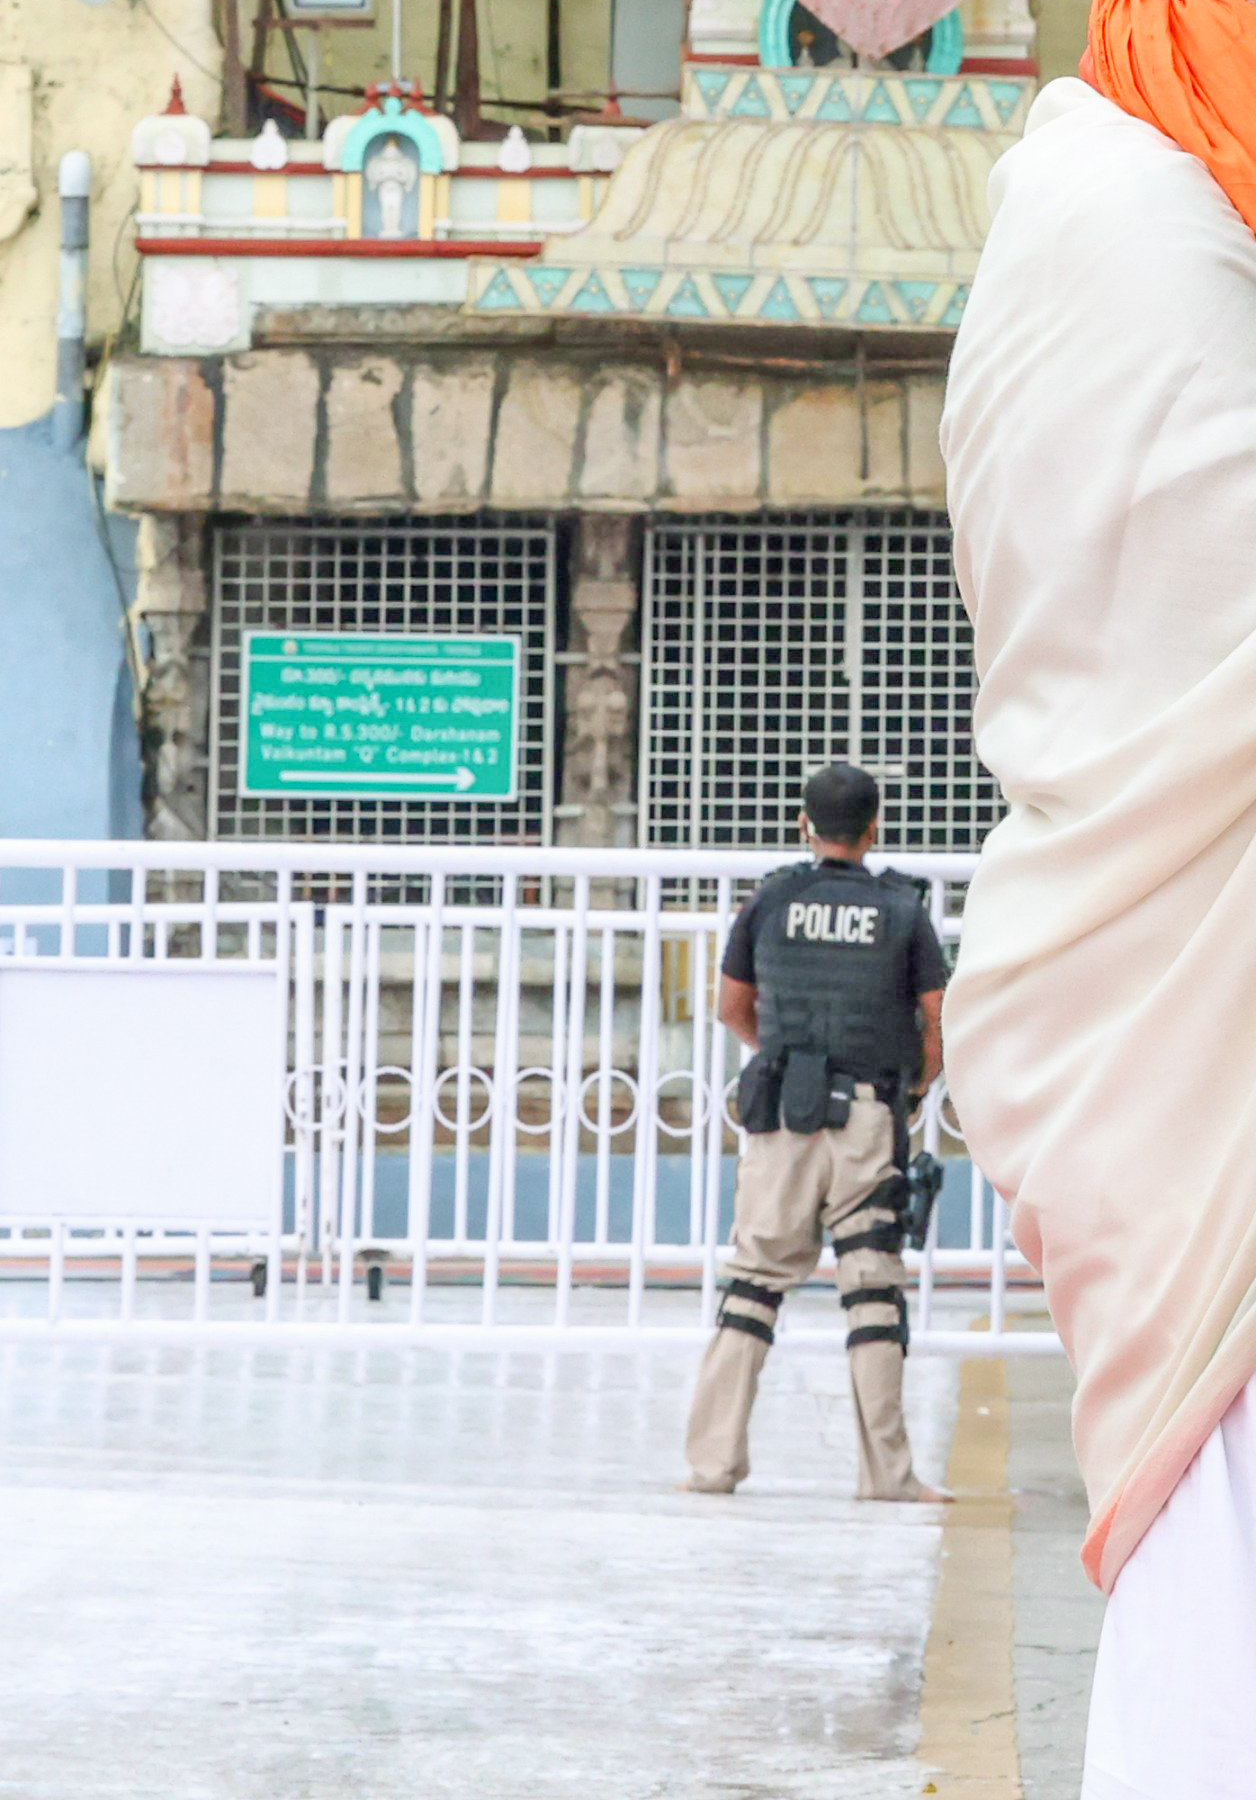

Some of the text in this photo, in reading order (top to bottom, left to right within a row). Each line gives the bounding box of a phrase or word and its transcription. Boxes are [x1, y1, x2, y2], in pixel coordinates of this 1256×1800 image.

[259, 723, 294, 742] Way
[298, 724, 319, 740] to
[410, 724, 502, 743] Darshanam
[786, 902, 879, 944] POLICE
